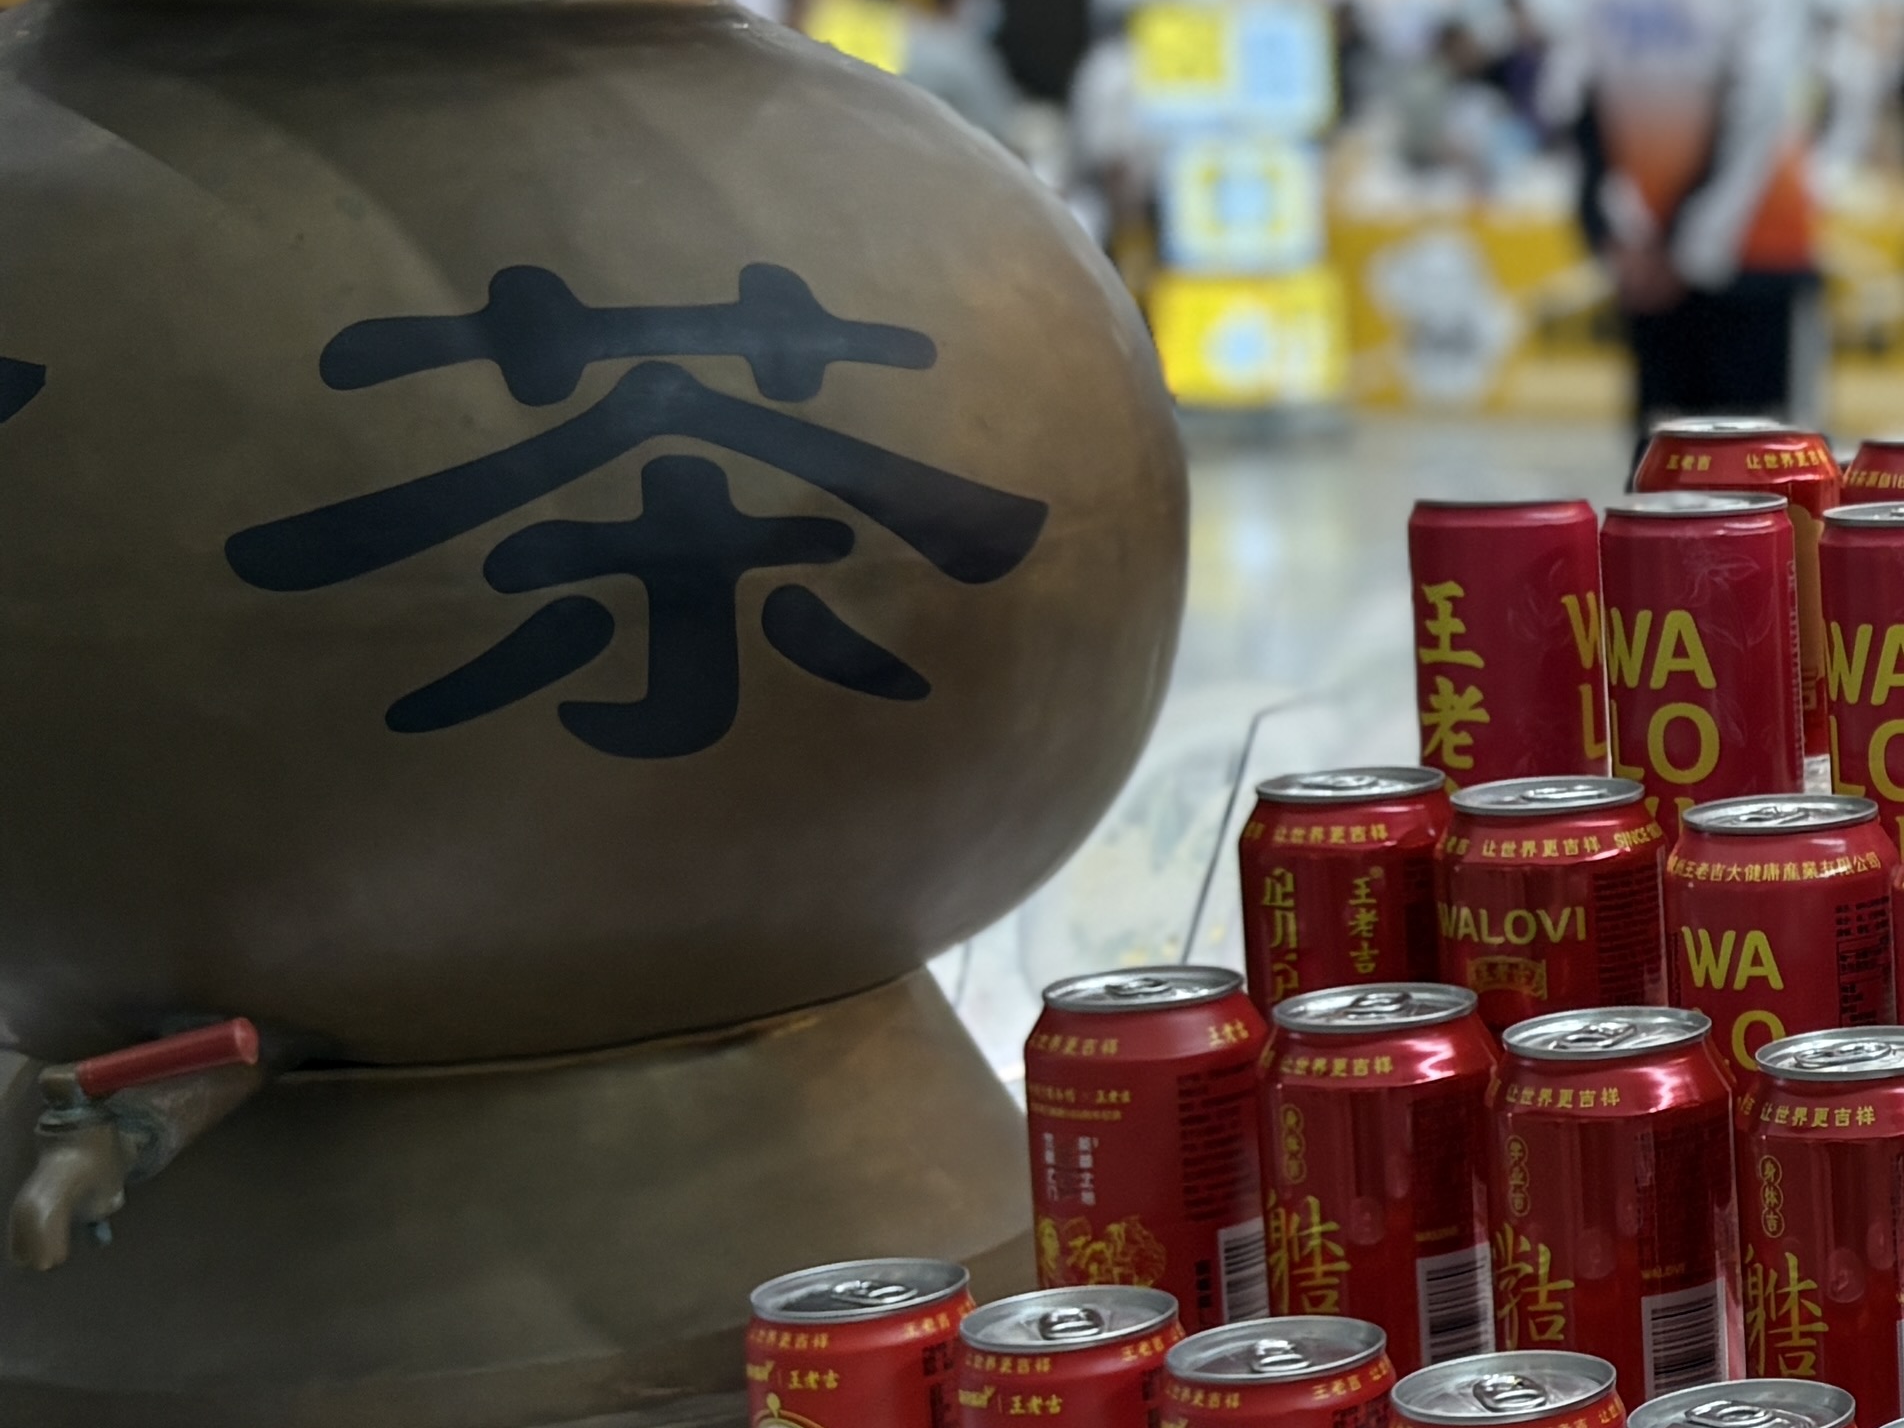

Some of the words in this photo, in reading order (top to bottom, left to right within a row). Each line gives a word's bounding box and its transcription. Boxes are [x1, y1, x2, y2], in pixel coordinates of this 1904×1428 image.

[223, 261, 1049, 759] 茶
[1419, 580, 1491, 780] 王老
[1481, 836, 1601, 859] 让世界更吉祥
[1349, 876, 1380, 974] 王老吉
[1438, 906, 1587, 947] WALOVI
[1681, 926, 1785, 992] WA
[1505, 1085, 1621, 1109] 让世界更吉祥
[1759, 1102, 1876, 1128] 让世界更吉祥
[788, 1370, 840, 1391] 王老吉
[1312, 1373, 1363, 1401] 王老吉
[1009, 1396, 1063, 1416] 王老吉
